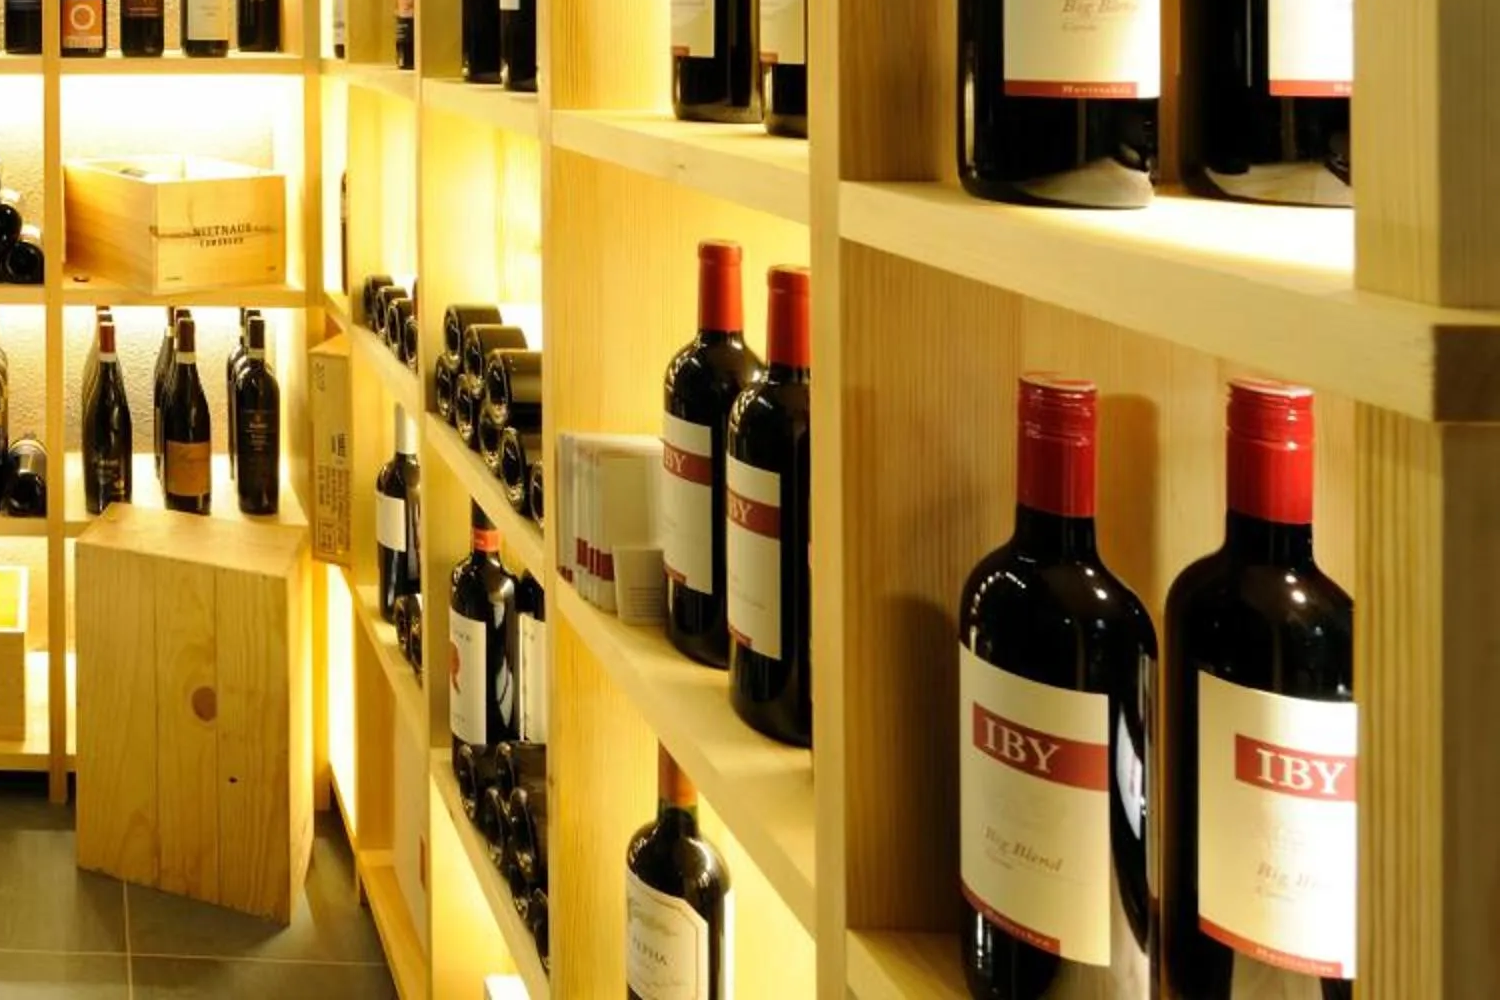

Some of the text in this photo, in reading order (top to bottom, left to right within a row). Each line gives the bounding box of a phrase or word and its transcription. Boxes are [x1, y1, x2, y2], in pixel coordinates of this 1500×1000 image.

[664, 451, 686, 473] BY
[728, 501, 752, 524] BY
[984, 717, 1060, 773] IBY
[1256, 747, 1348, 795] IBY
[1013, 842, 1064, 873] Blend
